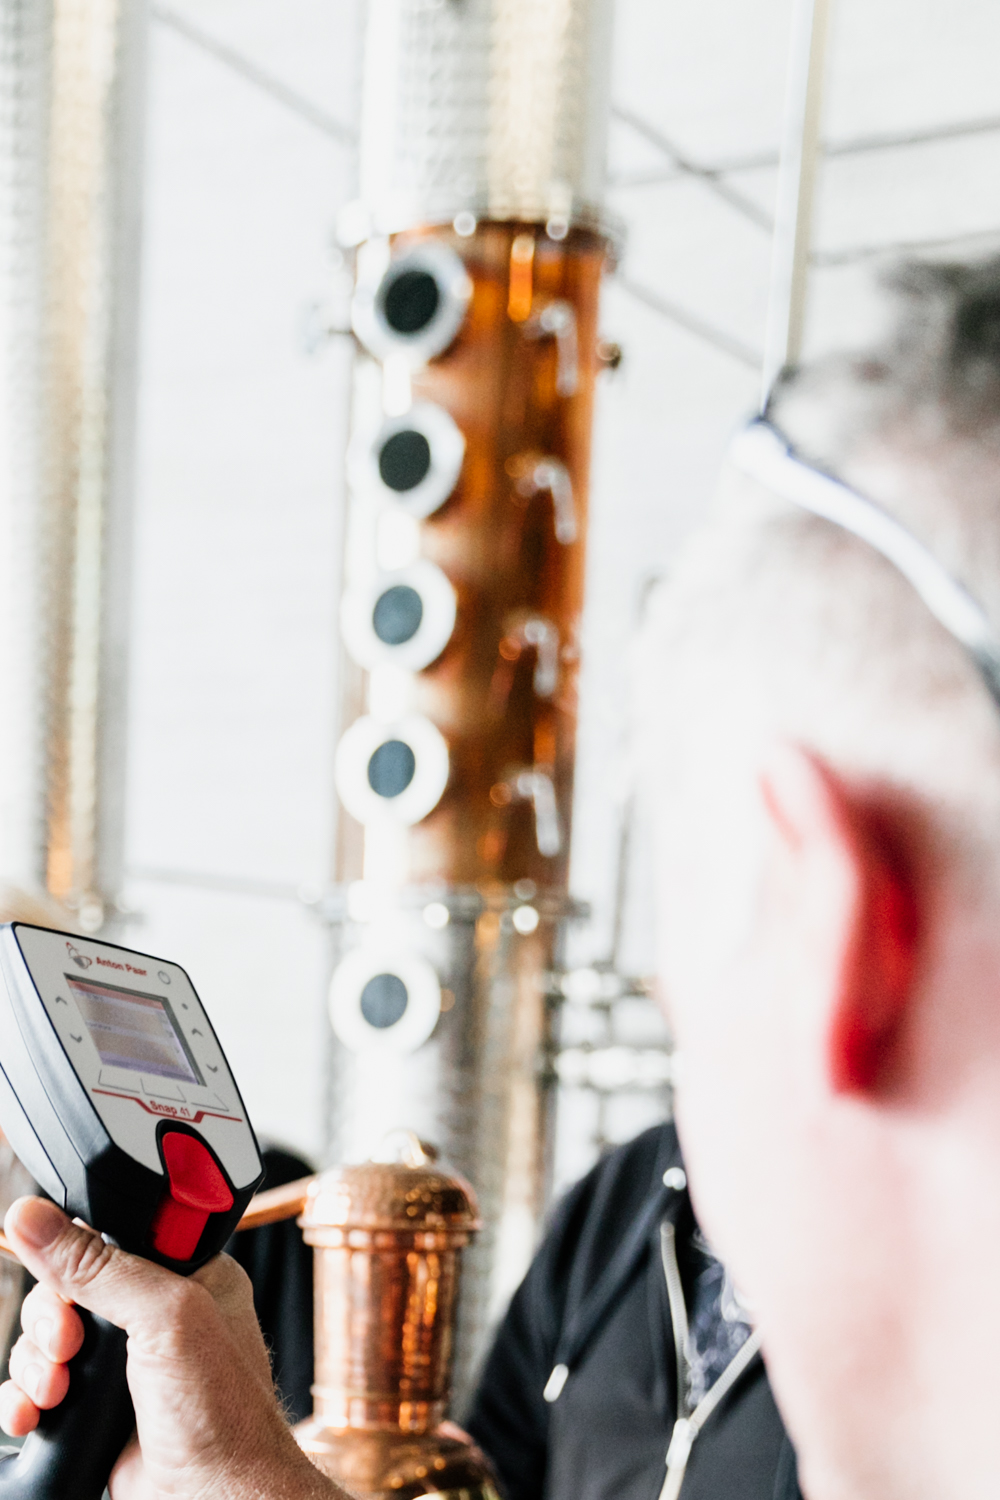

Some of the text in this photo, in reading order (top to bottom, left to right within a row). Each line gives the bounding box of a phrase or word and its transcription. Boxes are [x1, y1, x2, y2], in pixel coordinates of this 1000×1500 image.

[96, 956, 148, 977] Anton Paar
[149, 1100, 191, 1117] Snap 41
